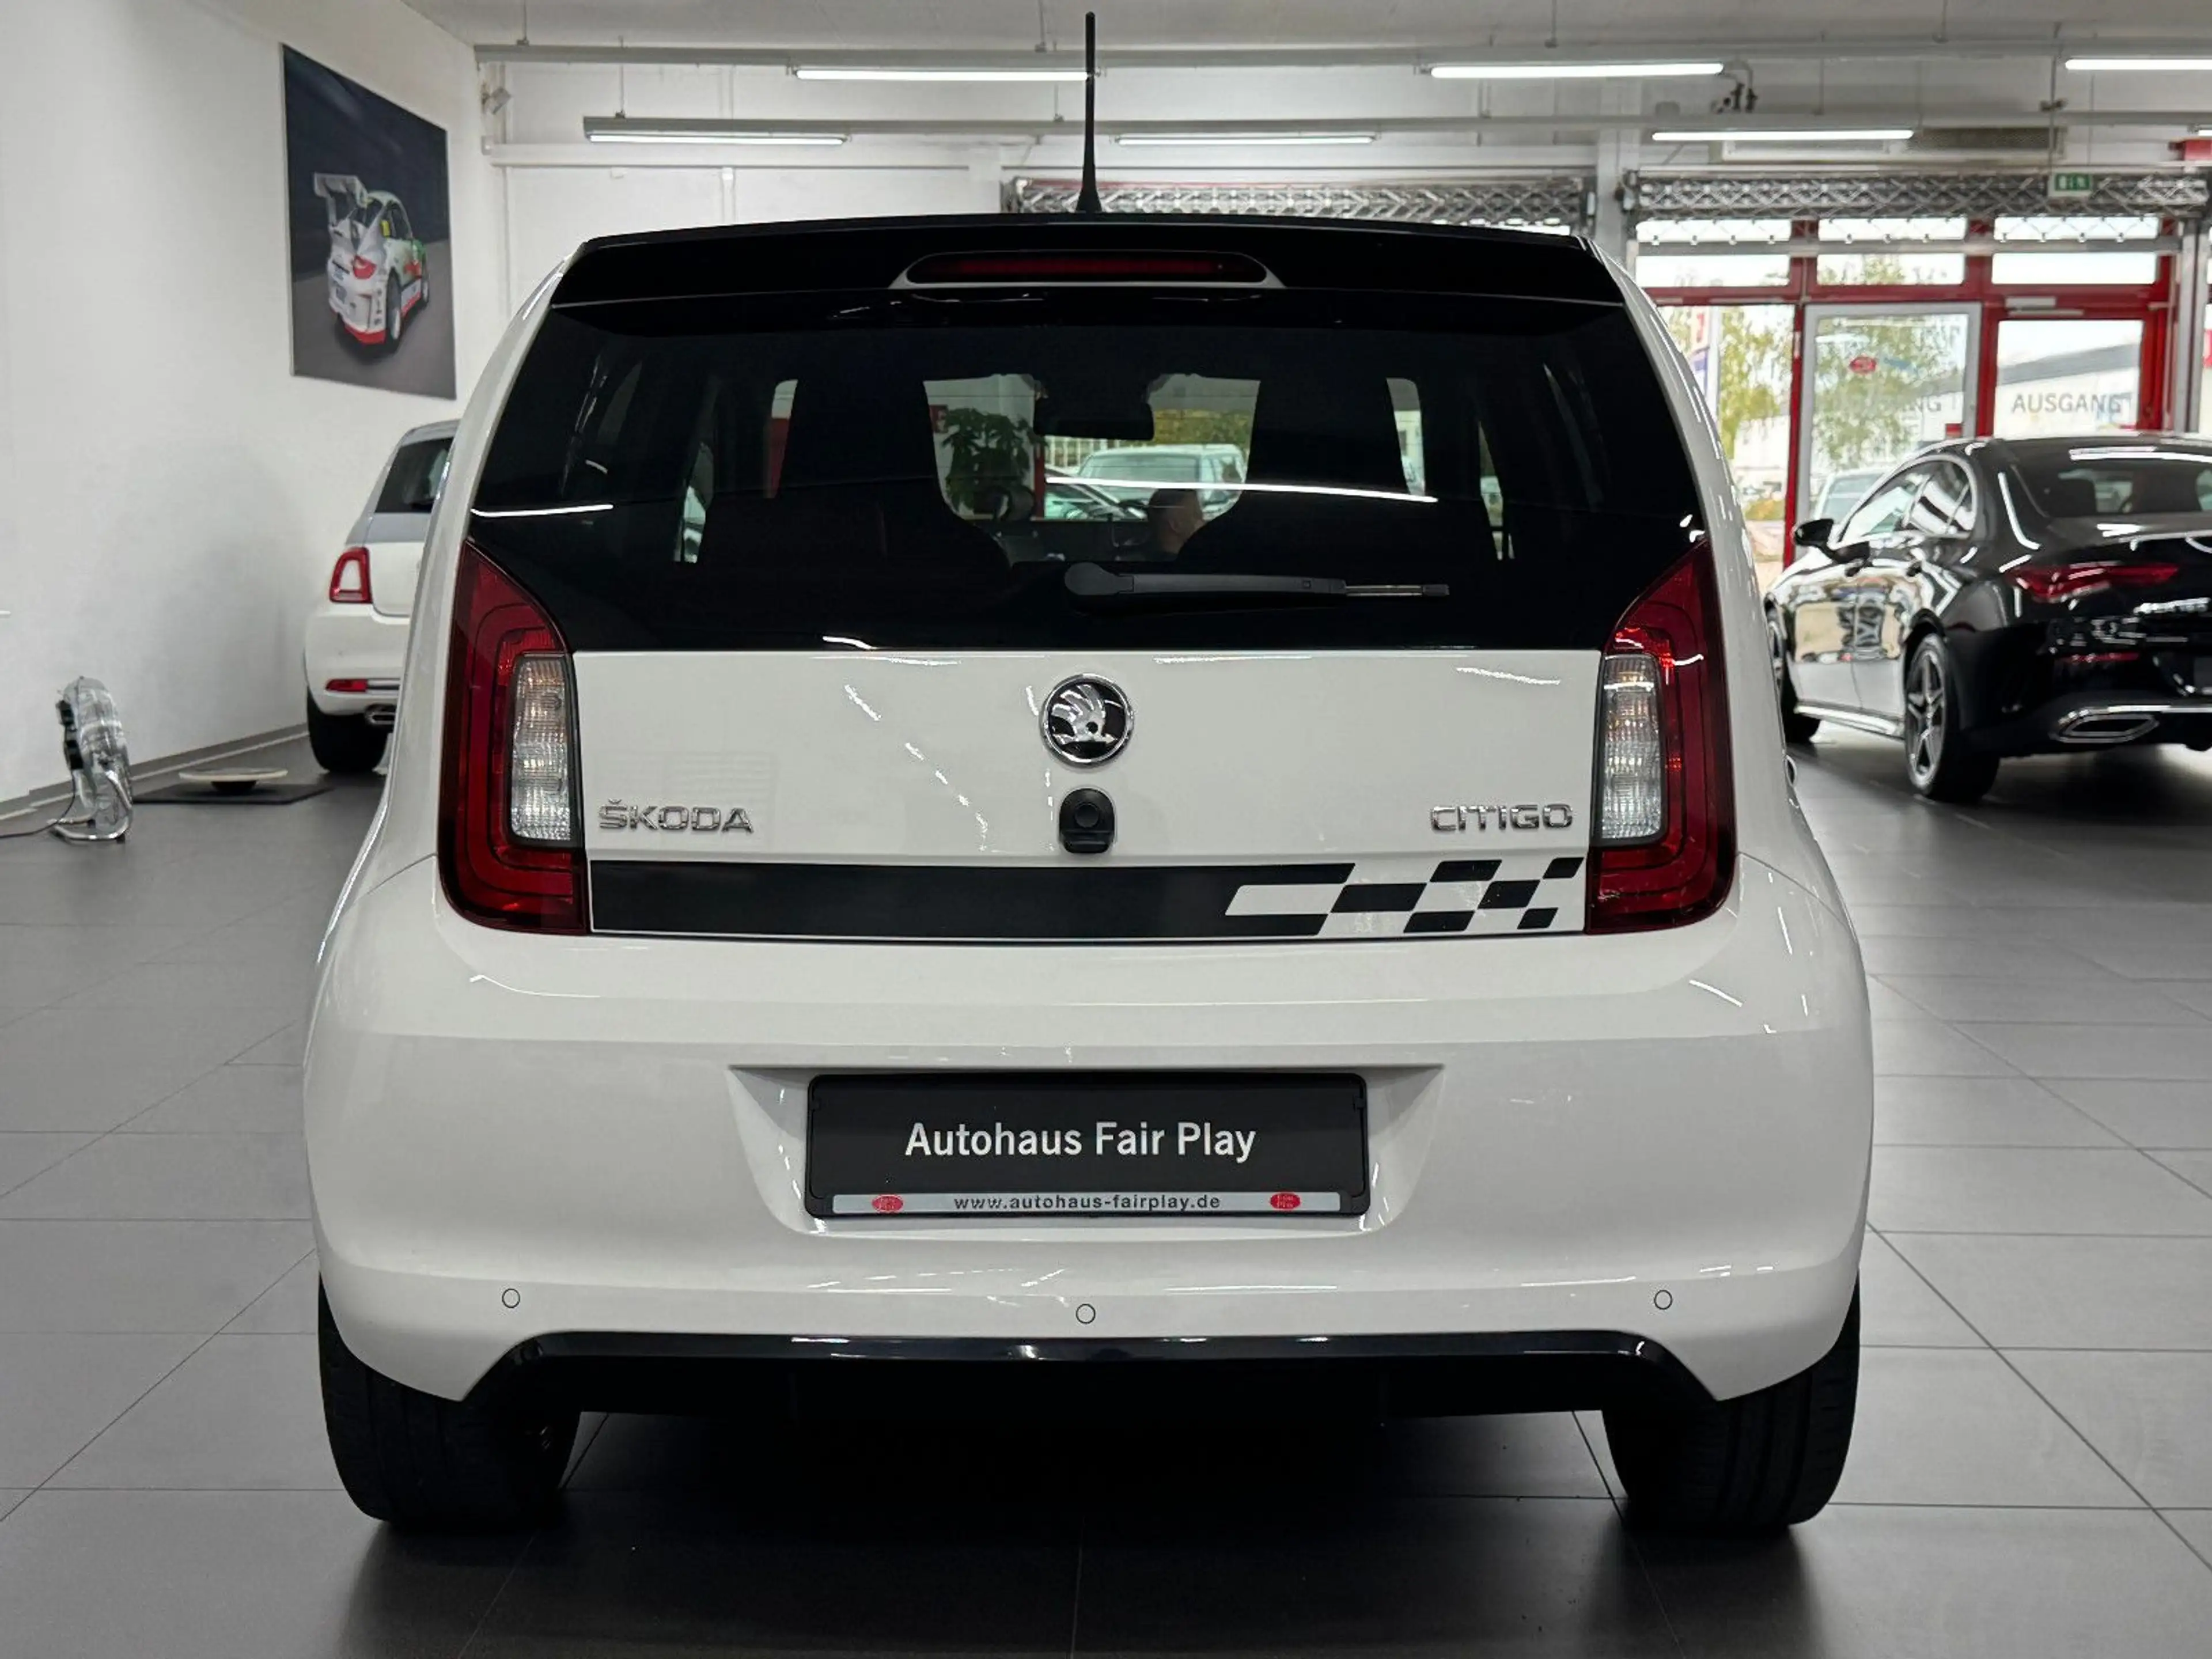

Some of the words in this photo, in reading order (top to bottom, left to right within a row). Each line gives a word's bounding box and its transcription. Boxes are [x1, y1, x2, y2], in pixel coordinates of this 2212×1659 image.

[2011, 393, 2122, 414] AUSGANG
[598, 797, 753, 833] ŠKODA
[1430, 803, 1573, 831] CITIGO
[904, 1122, 1082, 1156] Autohaus
[1096, 1121, 1165, 1156] Fair
[1177, 1121, 1257, 1164] Play
[953, 1194, 1221, 1211] www.autohaus-fairplay.de
